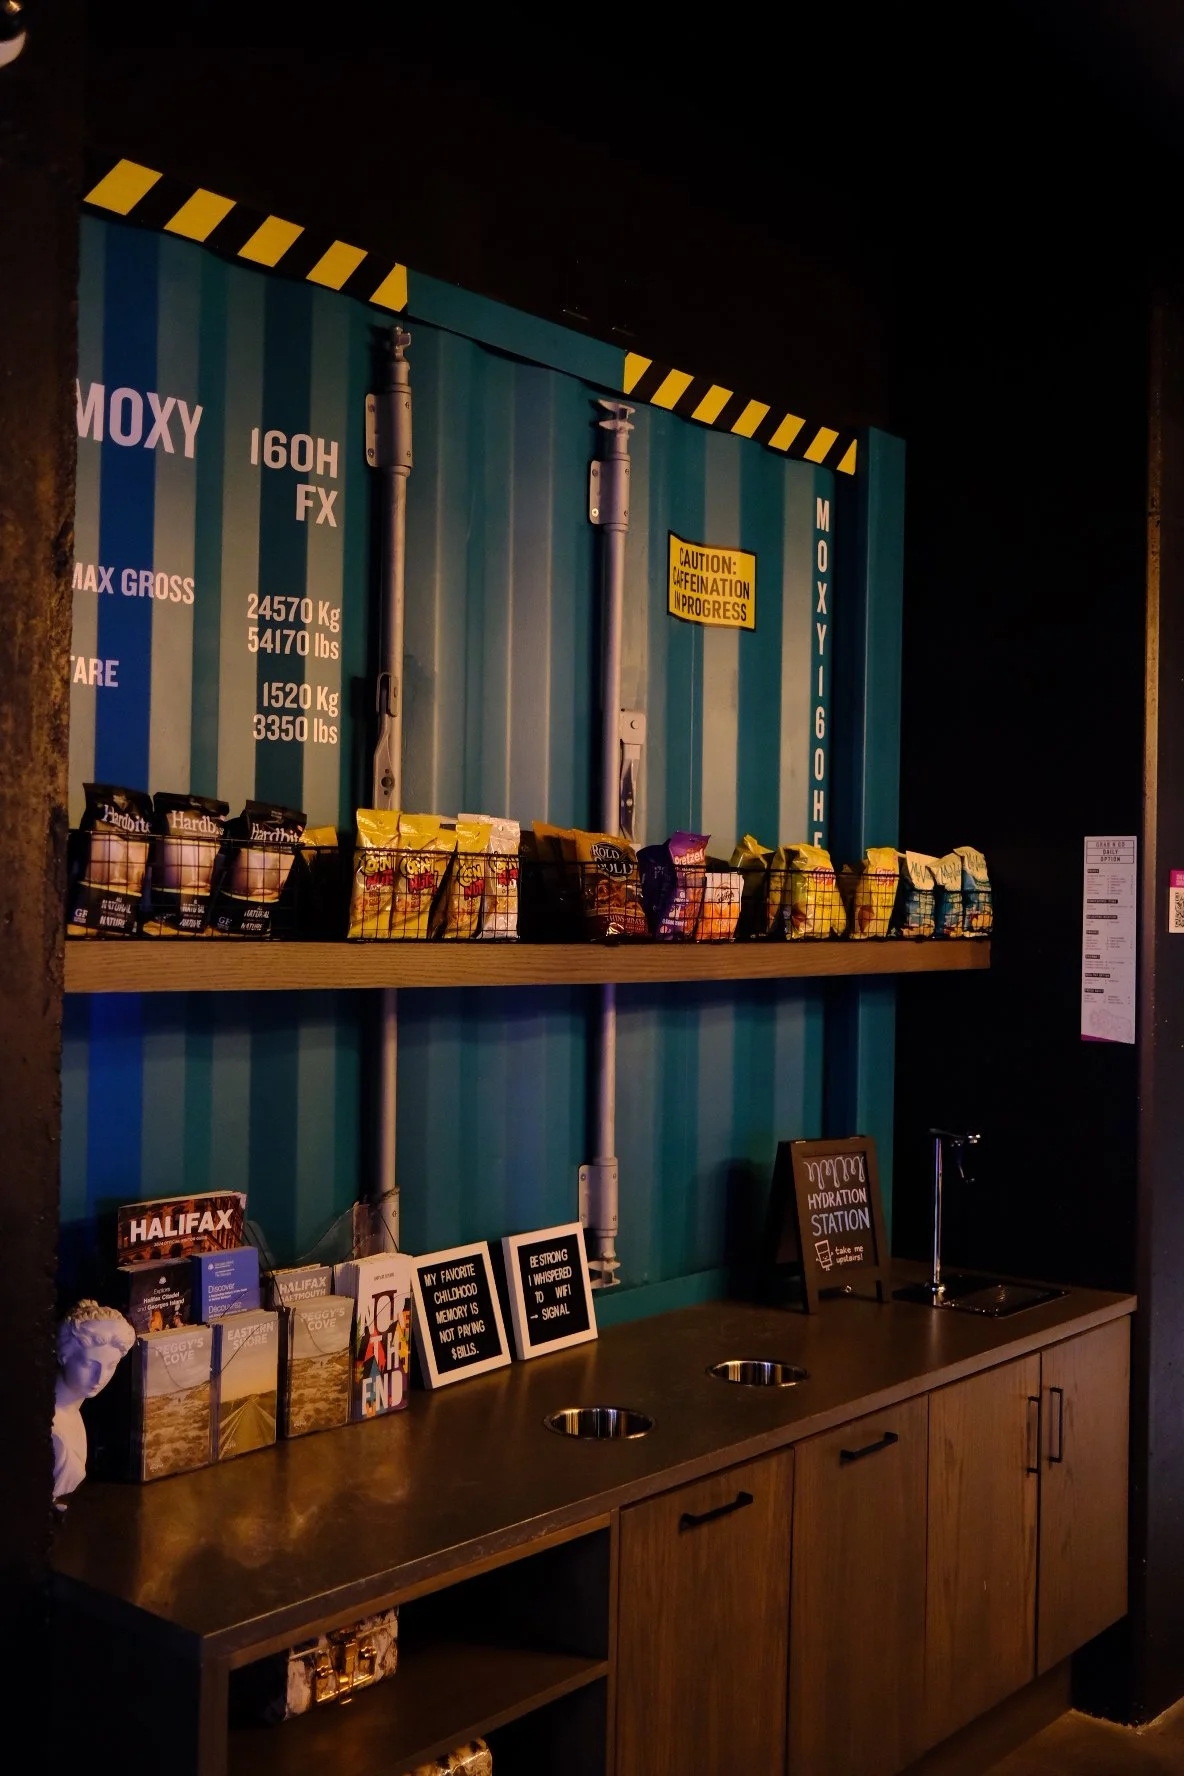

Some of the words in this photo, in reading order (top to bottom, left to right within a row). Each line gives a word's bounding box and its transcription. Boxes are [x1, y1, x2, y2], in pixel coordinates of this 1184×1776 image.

[76, 378, 204, 459] MOXY
[250, 427, 339, 479] 160H
[295, 483, 338, 528] FX
[680, 546, 736, 576] CAUTION:
[72, 562, 114, 594] MAX
[121, 568, 194, 604] GROSS
[672, 566, 750, 600] CAFFEINATION
[247, 593, 313, 624] 24570
[318, 601, 341, 632] Kg
[674, 590, 681, 611] IN
[682, 594, 746, 622] PROGRESS
[248, 627, 310, 656] 54170
[315, 633, 340, 660] lbs
[263, 682, 312, 710] 1520
[316, 686, 339, 718] Kg
[253, 714, 308, 742] 3350
[314, 717, 338, 744] lbs
[592, 844, 620, 860] ROLD
[808, 1188, 868, 1210] HYDRATION
[130, 1209, 234, 1242] HALIFAX
[811, 1207, 870, 1237] STATION
[530, 1254, 538, 1268] BE
[539, 1249, 568, 1266] STRONG
[835, 1246, 851, 1256] take
[836, 1254, 864, 1264] upstairs!
[280, 1276, 326, 1294] HALIFAX
[424, 1274, 436, 1287] MY
[440, 1264, 476, 1284] FAVORITE
[534, 1266, 572, 1286] WHISPERED
[434, 1282, 477, 1304] CHILDHOOD
[535, 1290, 544, 1304] TO
[555, 1285, 572, 1298] WIFI
[436, 1304, 468, 1324] MEMORY
[470, 1302, 479, 1316] IS
[542, 1303, 570, 1321] SIGNAL
[228, 1321, 274, 1340] EASTERN
[308, 1318, 336, 1331] COVE
[439, 1328, 455, 1344] NOT
[458, 1320, 485, 1339] PAYING
[164, 1350, 194, 1365] COVE
